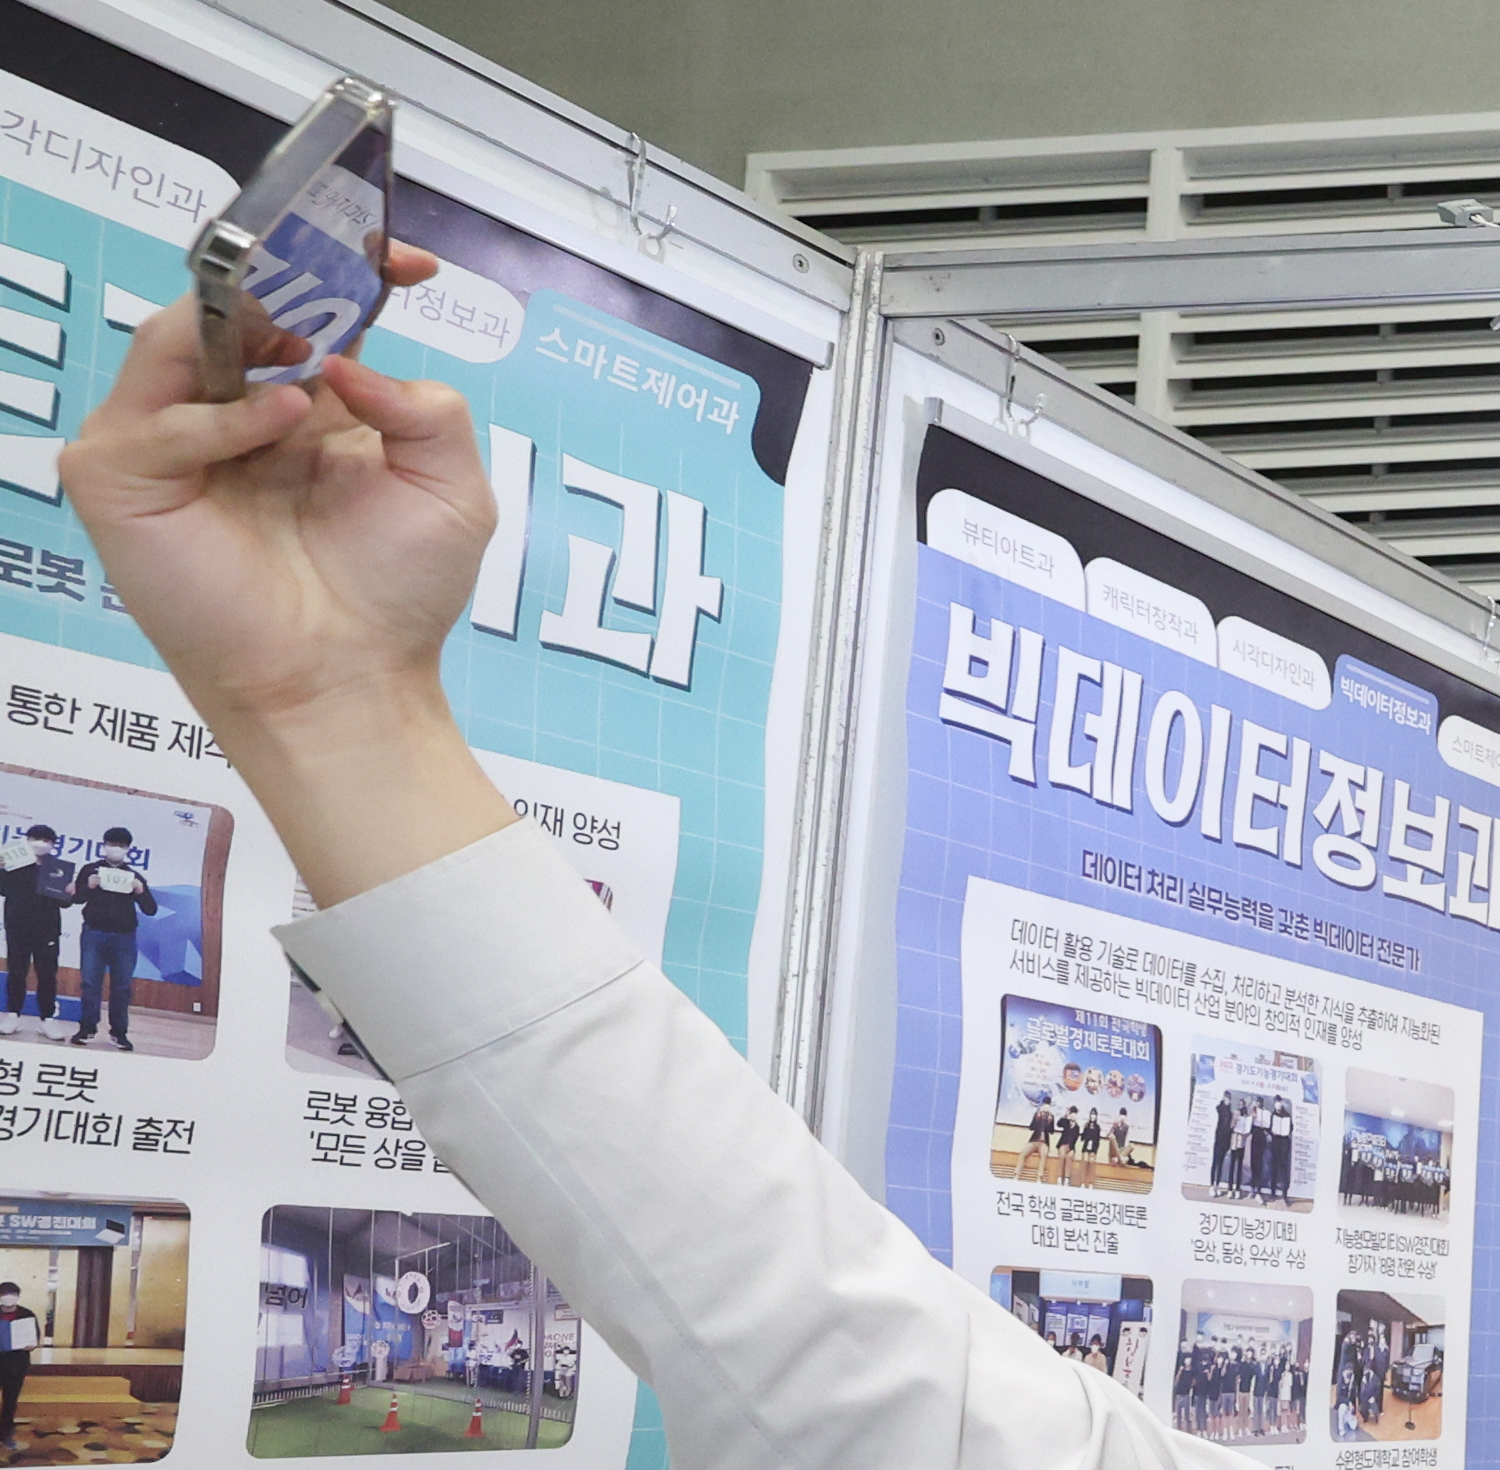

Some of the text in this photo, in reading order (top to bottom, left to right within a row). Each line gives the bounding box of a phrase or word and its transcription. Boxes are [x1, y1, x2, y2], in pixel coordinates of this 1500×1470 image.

[534, 327, 741, 434] 스마트제어과
[961, 518, 1055, 580] 뷰티아트과
[1101, 584, 1199, 646] 캐릭터창작과
[1231, 639, 1316, 693] 시각디자인과
[6, 684, 160, 752] 통한 제품
[1340, 675, 1432, 736] 빅데이터정보과
[572, 812, 621, 851] 양성
[1081, 849, 1421, 972] 데이터 처리 실무능력을 빅데이터 전문가
[1009, 949, 1191, 1012] 서비스를 제공하는 빅데이터
[1010, 918, 1198, 987] 데이터 활용 기술로 데이터를
[32, 1063, 99, 1103] 로봇
[303, 1090, 358, 1127] 로봇
[132, 1116, 195, 1155] 출전
[309, 1130, 367, 1167] '모든
[373, 1138, 427, 1173] 상을
[996, 1190, 1149, 1230] 전국 학생 글로벌경제토론
[1031, 1224, 1120, 1255] 대회 본선 진출
